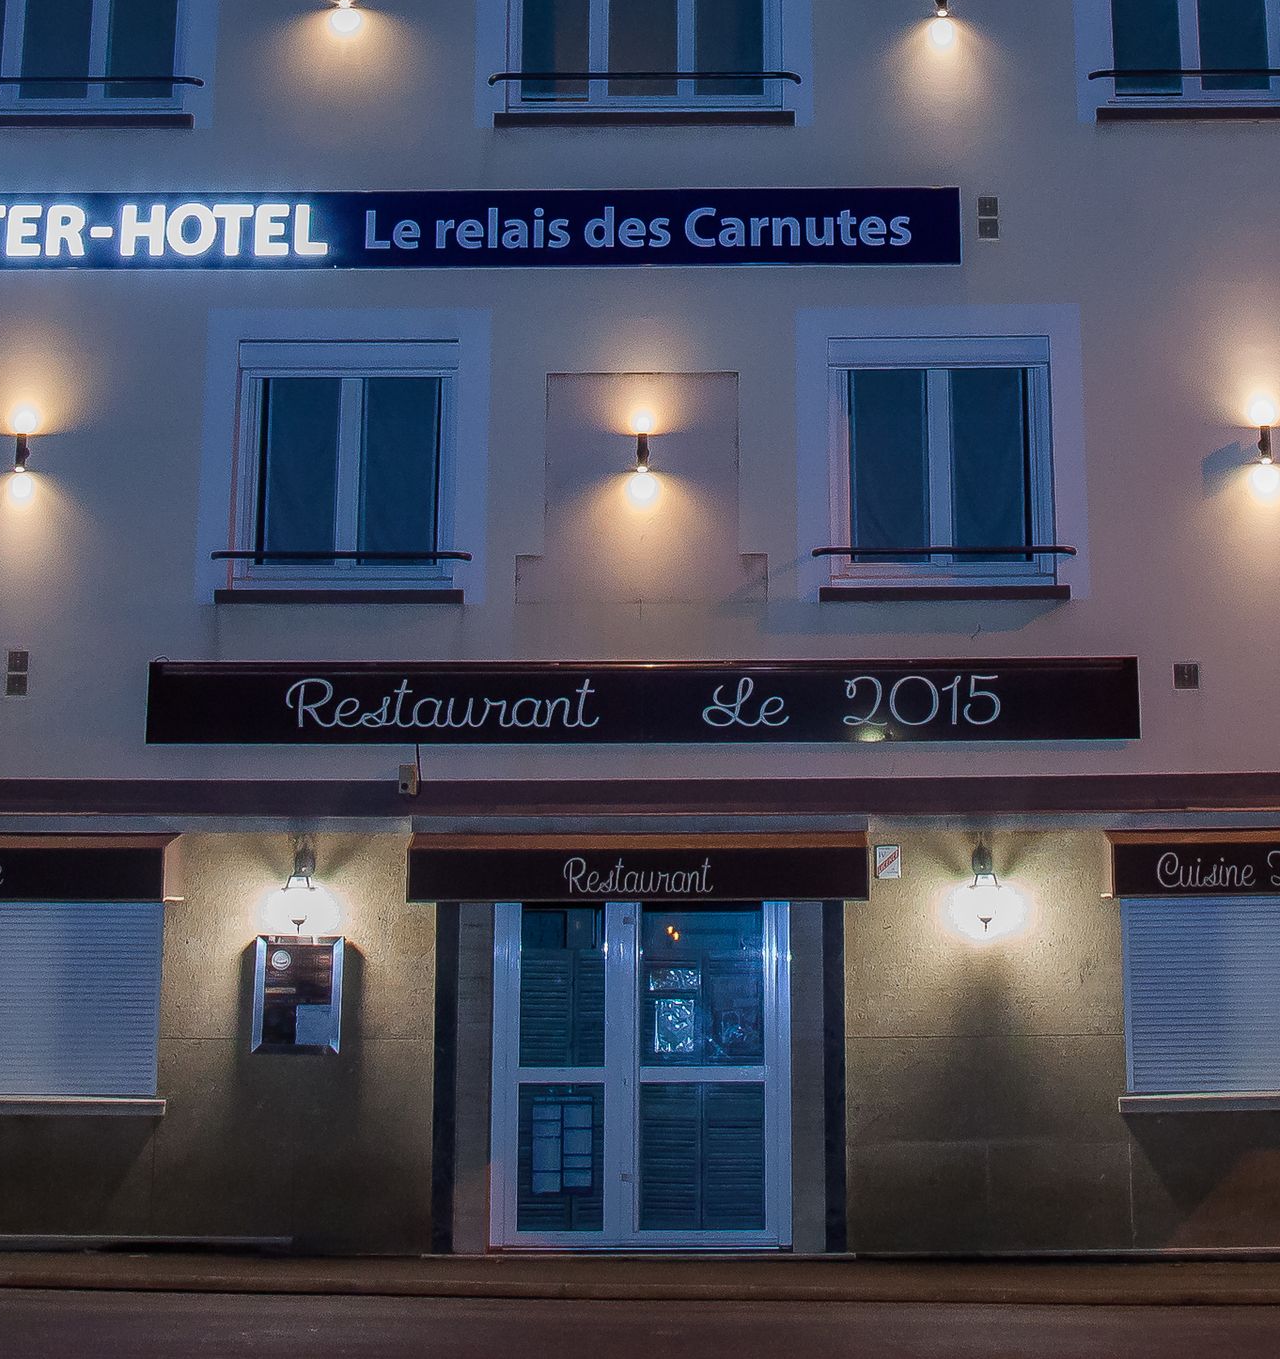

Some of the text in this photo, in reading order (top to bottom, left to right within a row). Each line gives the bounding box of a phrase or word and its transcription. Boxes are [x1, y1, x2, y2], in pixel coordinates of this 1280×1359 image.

[364, 206, 912, 250] Le relais des Carnutes
[285, 675, 1001, 728] Restaurant Le 2015
[563, 856, 714, 894] Restaurant
[1156, 852, 1257, 888] Cuisine
